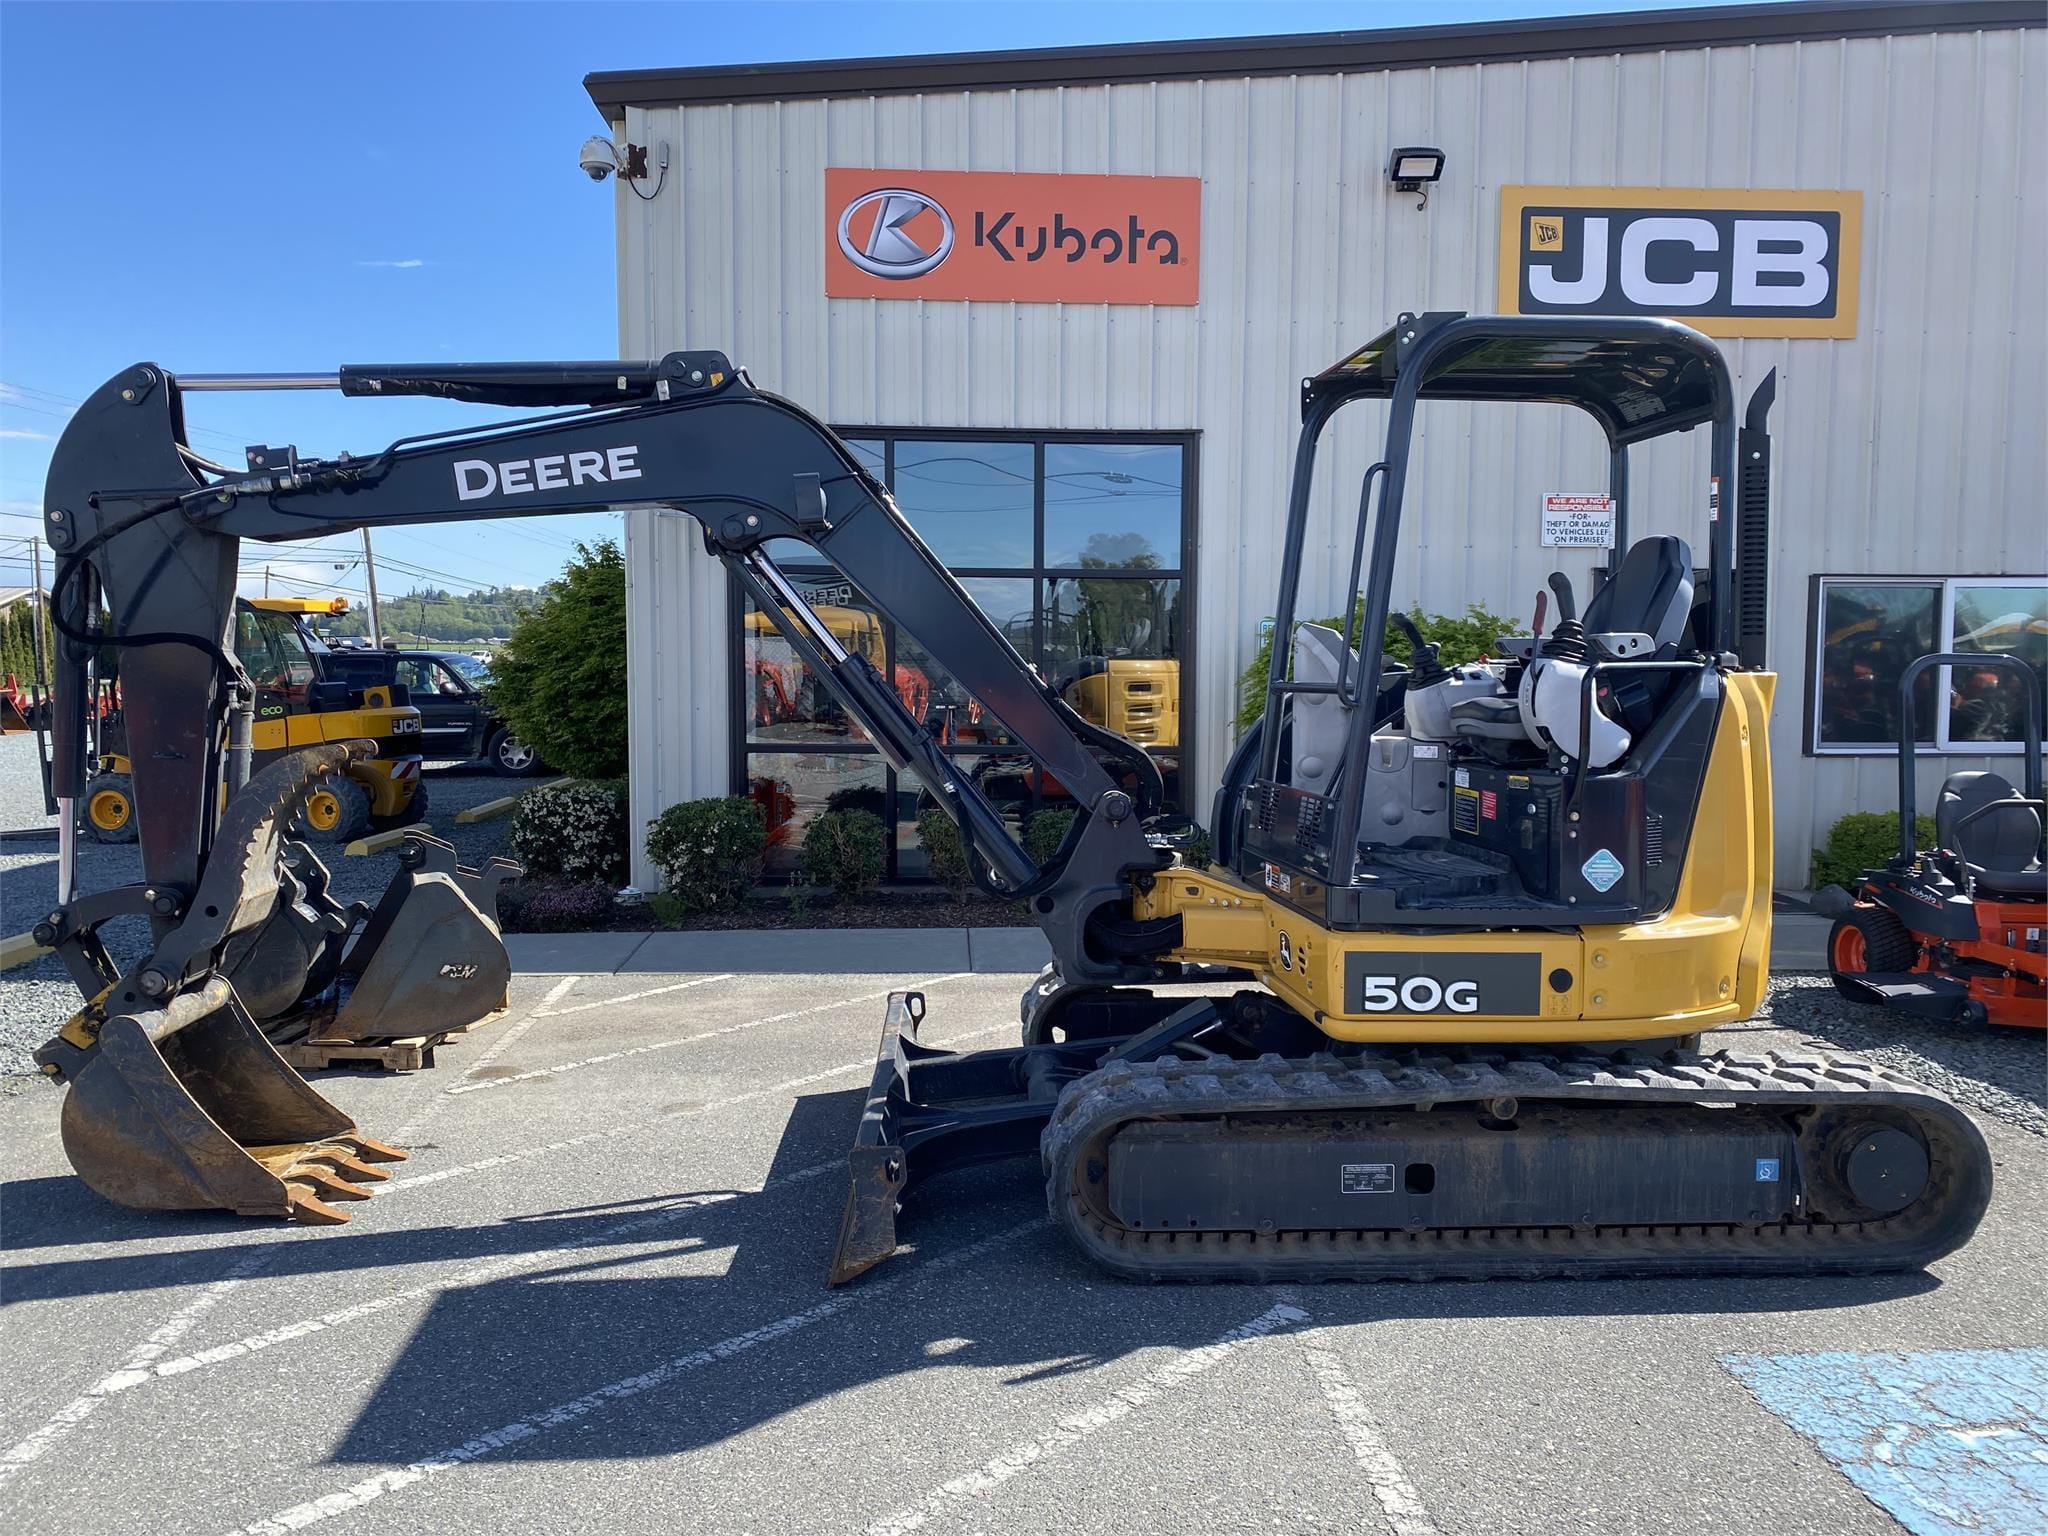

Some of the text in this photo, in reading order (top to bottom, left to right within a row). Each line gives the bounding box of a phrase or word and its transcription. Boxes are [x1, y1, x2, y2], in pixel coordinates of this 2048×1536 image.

[974, 211, 1179, 265] Kubota
[1538, 224, 1558, 243] JCB
[1528, 217, 1830, 307] JCB
[453, 445, 642, 501] DEERE
[1559, 528, 1594, 536] VEHICLES
[260, 705, 283, 716] eco
[393, 718, 419, 734] JCB
[1364, 976, 1478, 1013] 50G
